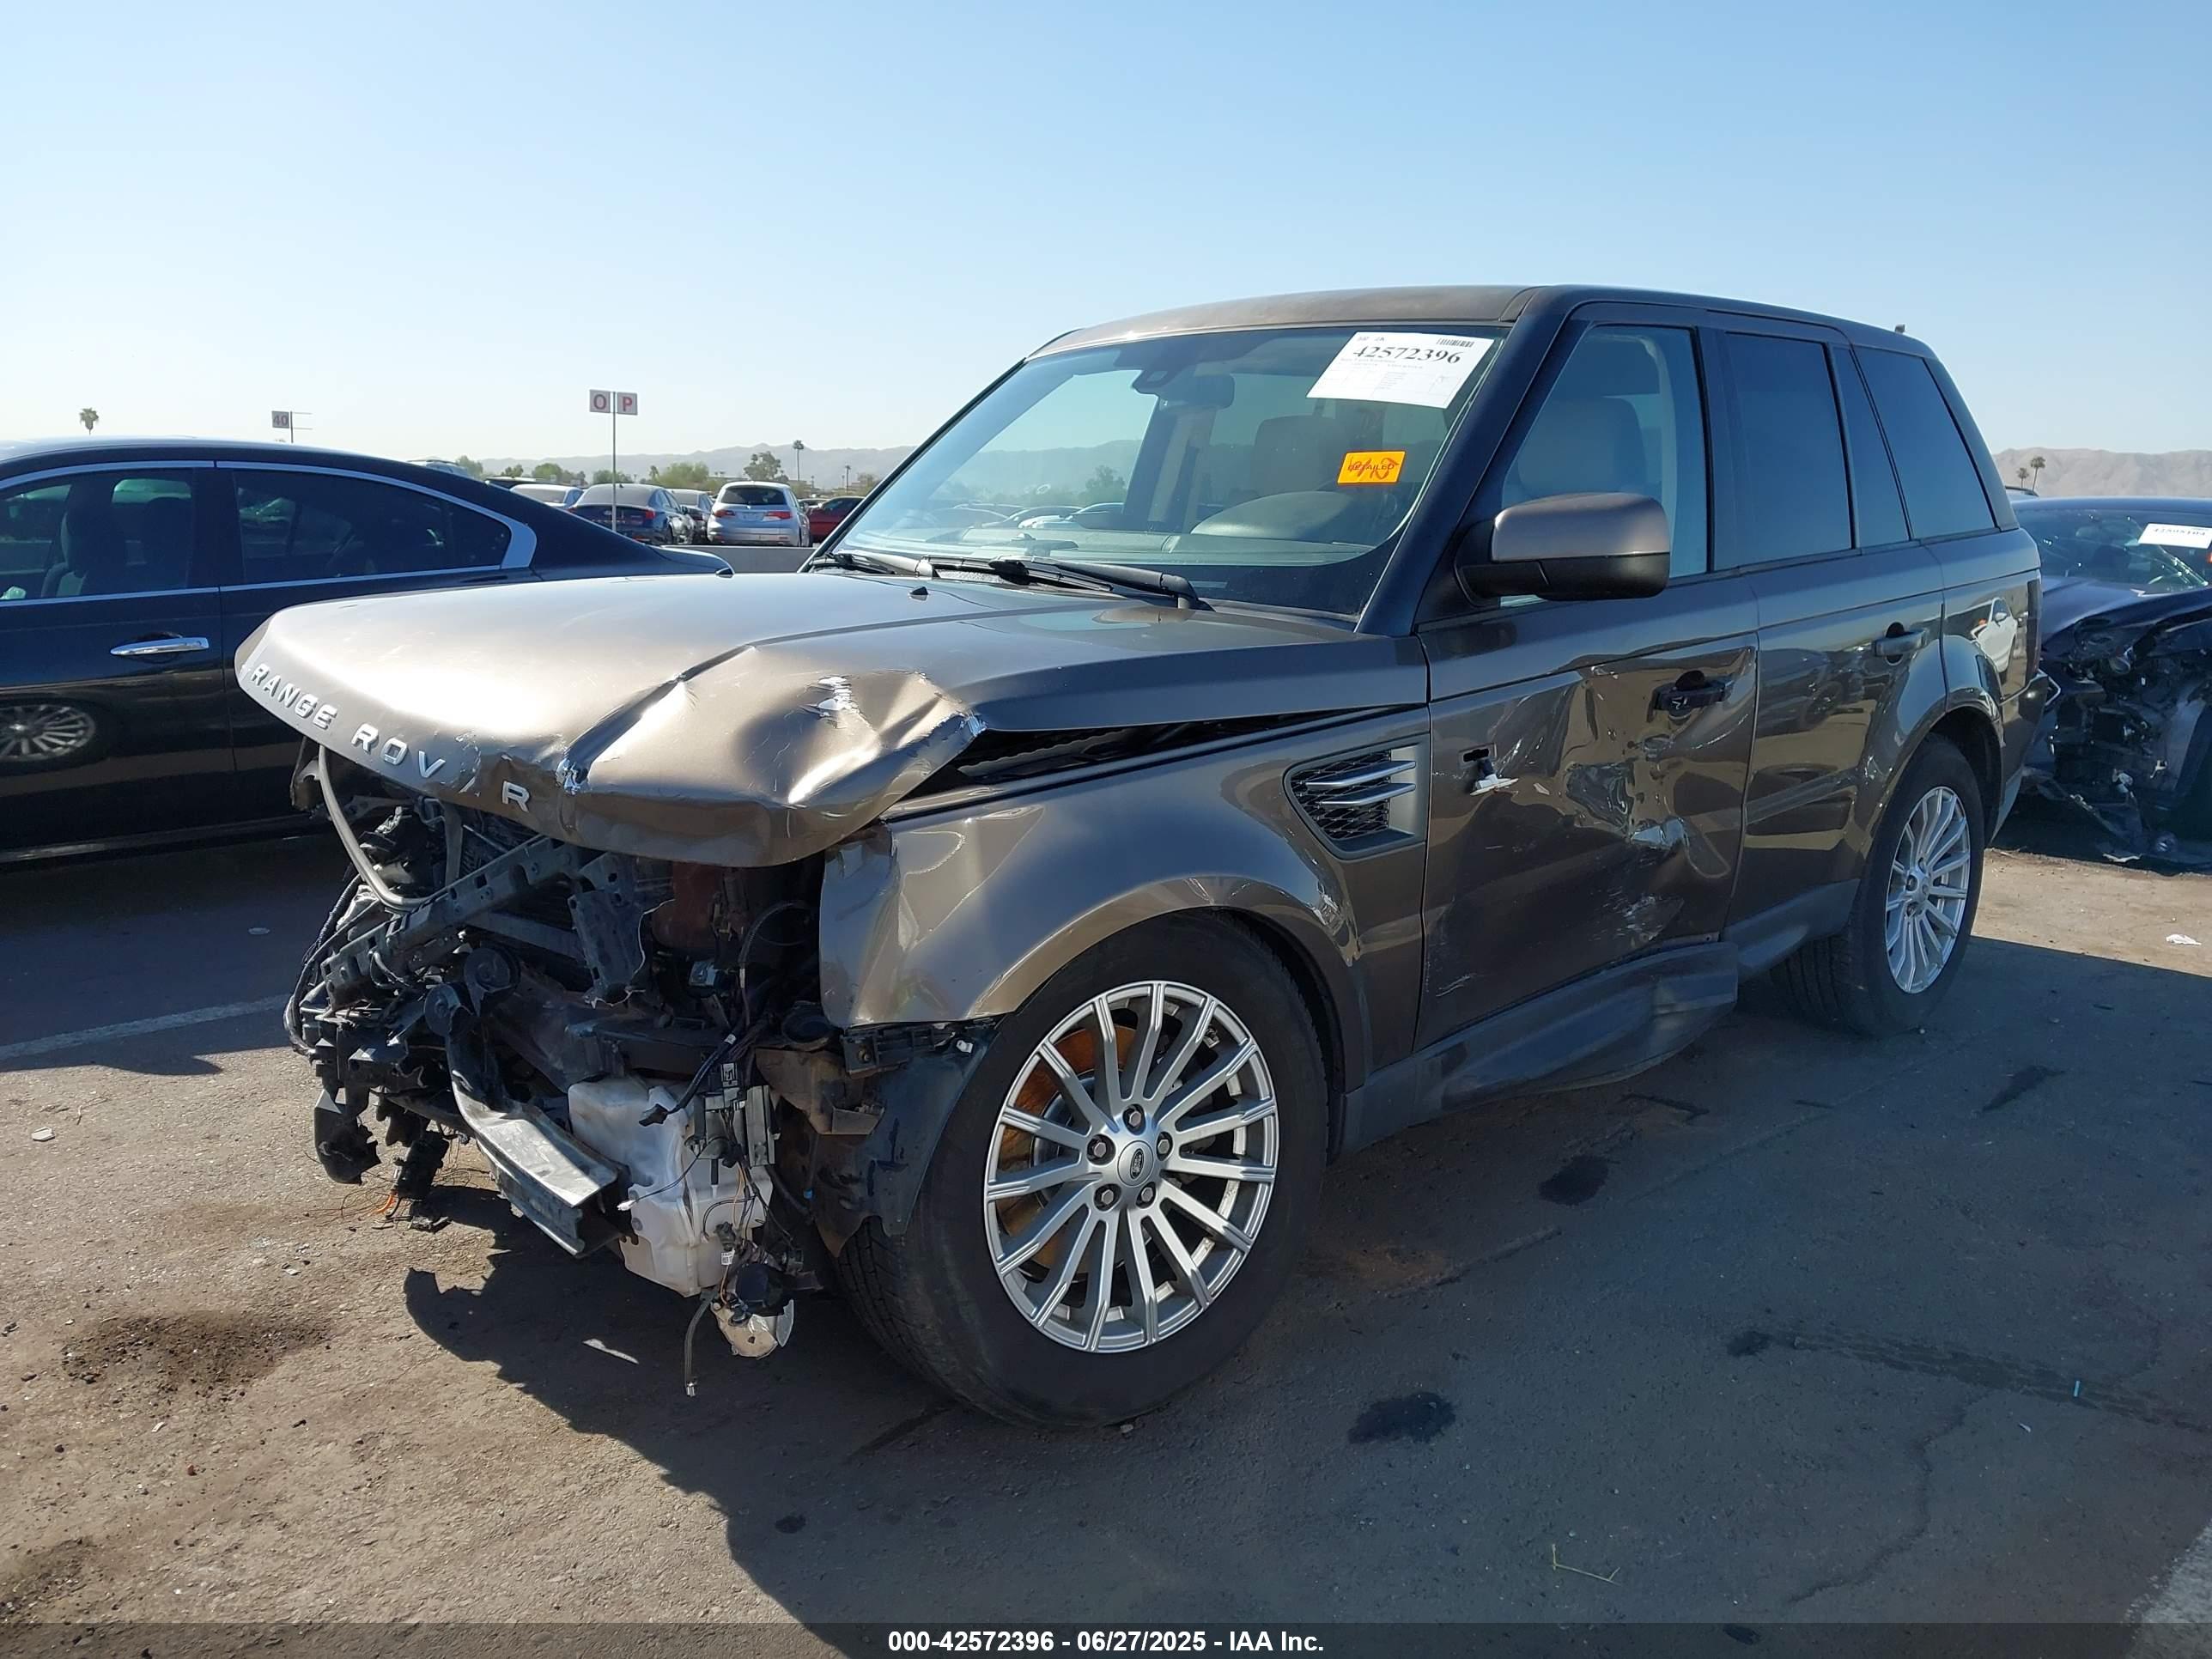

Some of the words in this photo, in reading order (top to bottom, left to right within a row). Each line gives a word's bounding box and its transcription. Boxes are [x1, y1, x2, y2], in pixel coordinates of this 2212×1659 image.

[1353, 346, 1463, 364] 42572396
[593, 393, 606, 410] O
[622, 397, 633, 411] P
[250, 663, 337, 730] RANGE
